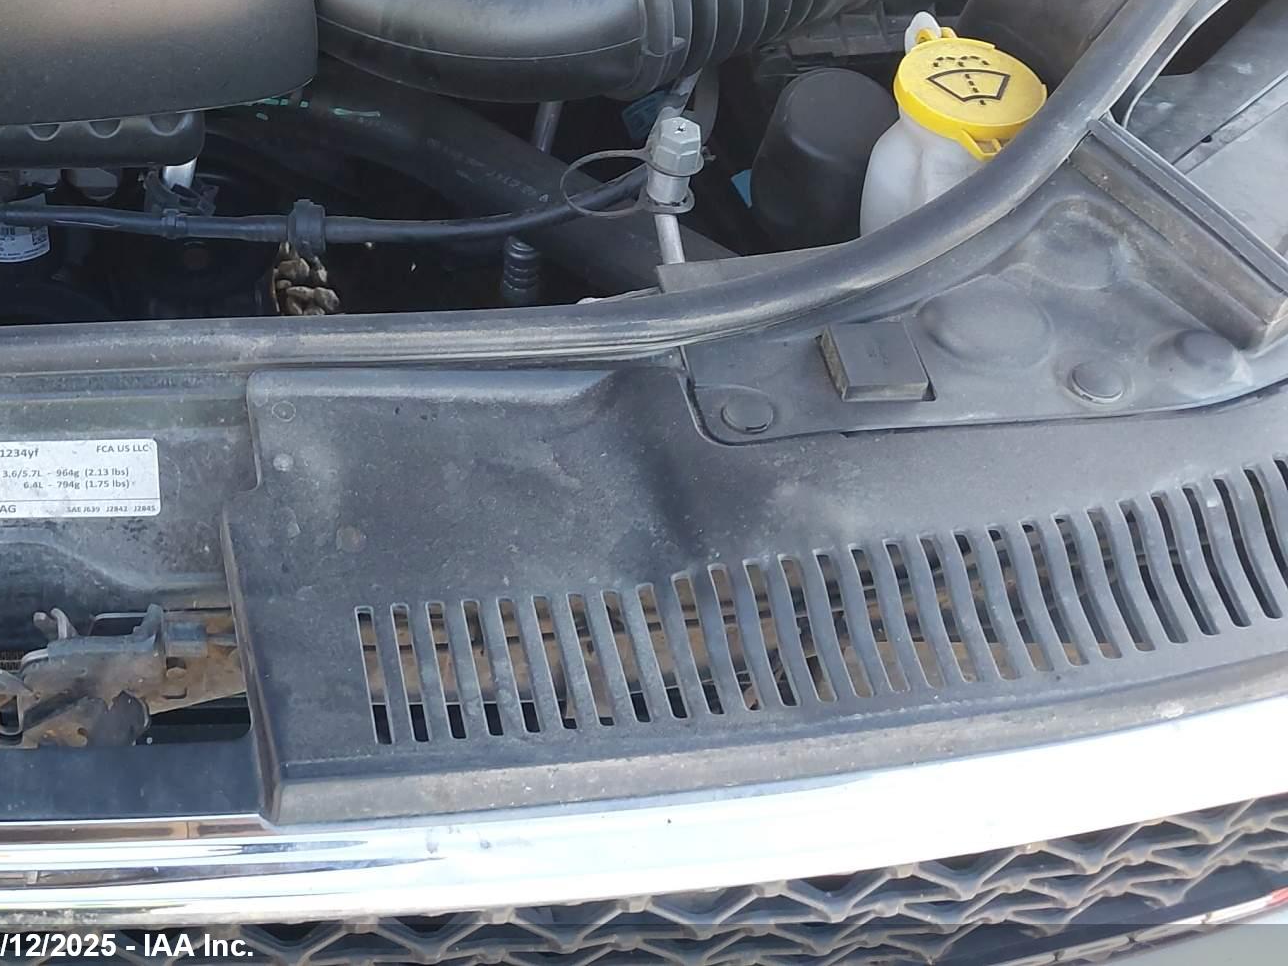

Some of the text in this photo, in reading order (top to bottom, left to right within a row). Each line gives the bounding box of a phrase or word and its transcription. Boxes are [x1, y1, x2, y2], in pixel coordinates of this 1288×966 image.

[96, 444, 114, 453] FCA
[117, 444, 130, 453] US
[132, 443, 149, 452] LLC
[2, 469, 42, 479] 3.6/5.7L
[56, 468, 80, 479] 964g
[84, 468, 109, 478] (2.13
[112, 467, 129, 477] lbs)
[23, 481, 44, 489] 6.4L
[56, 480, 80, 490] 794g
[85, 480, 109, 489] (1.75
[112, 479, 130, 489] lbs)
